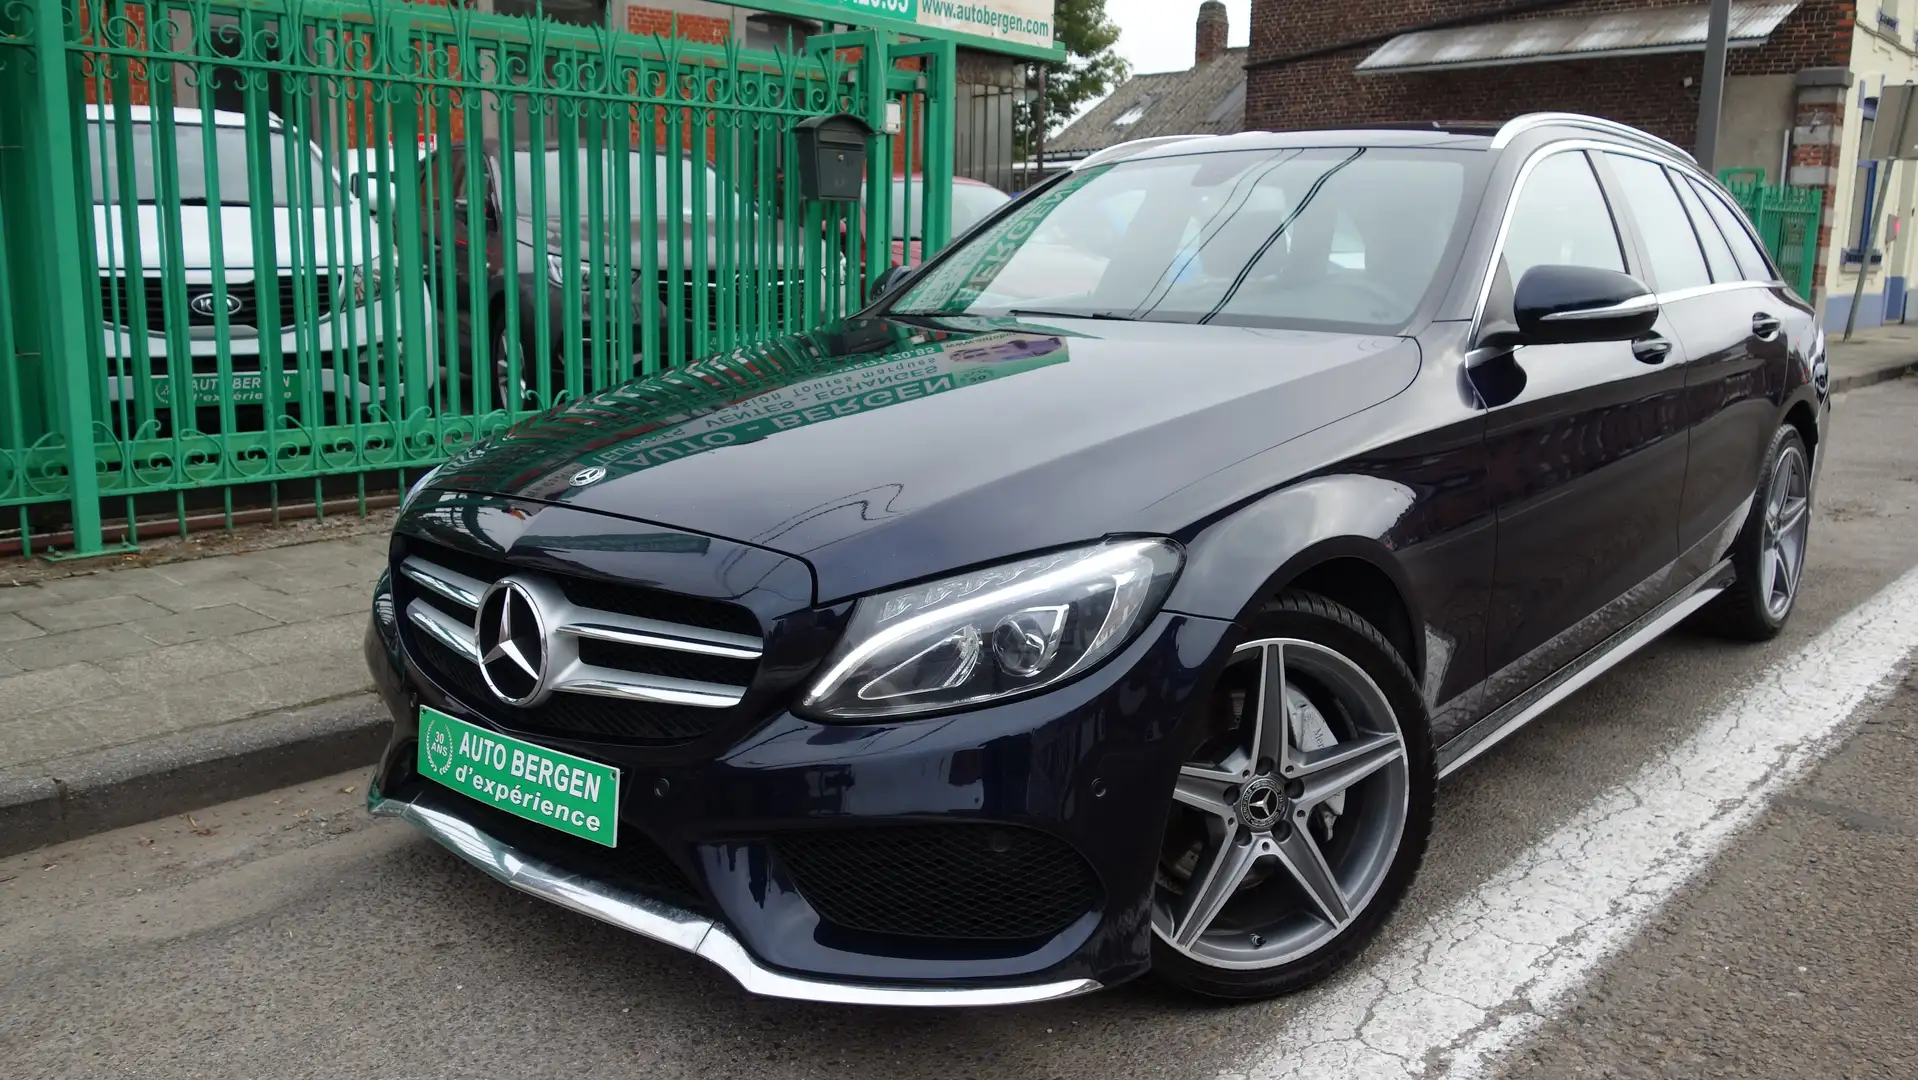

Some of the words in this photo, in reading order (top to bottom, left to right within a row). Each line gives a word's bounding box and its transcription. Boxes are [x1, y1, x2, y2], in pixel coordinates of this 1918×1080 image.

[921, 0, 1049, 37] www.autobergen.com
[430, 742, 448, 757] ANS
[434, 731, 445, 744] 30
[459, 731, 507, 771] AUTO
[510, 749, 601, 803] BERGEN
[455, 764, 601, 832] d'expérience
